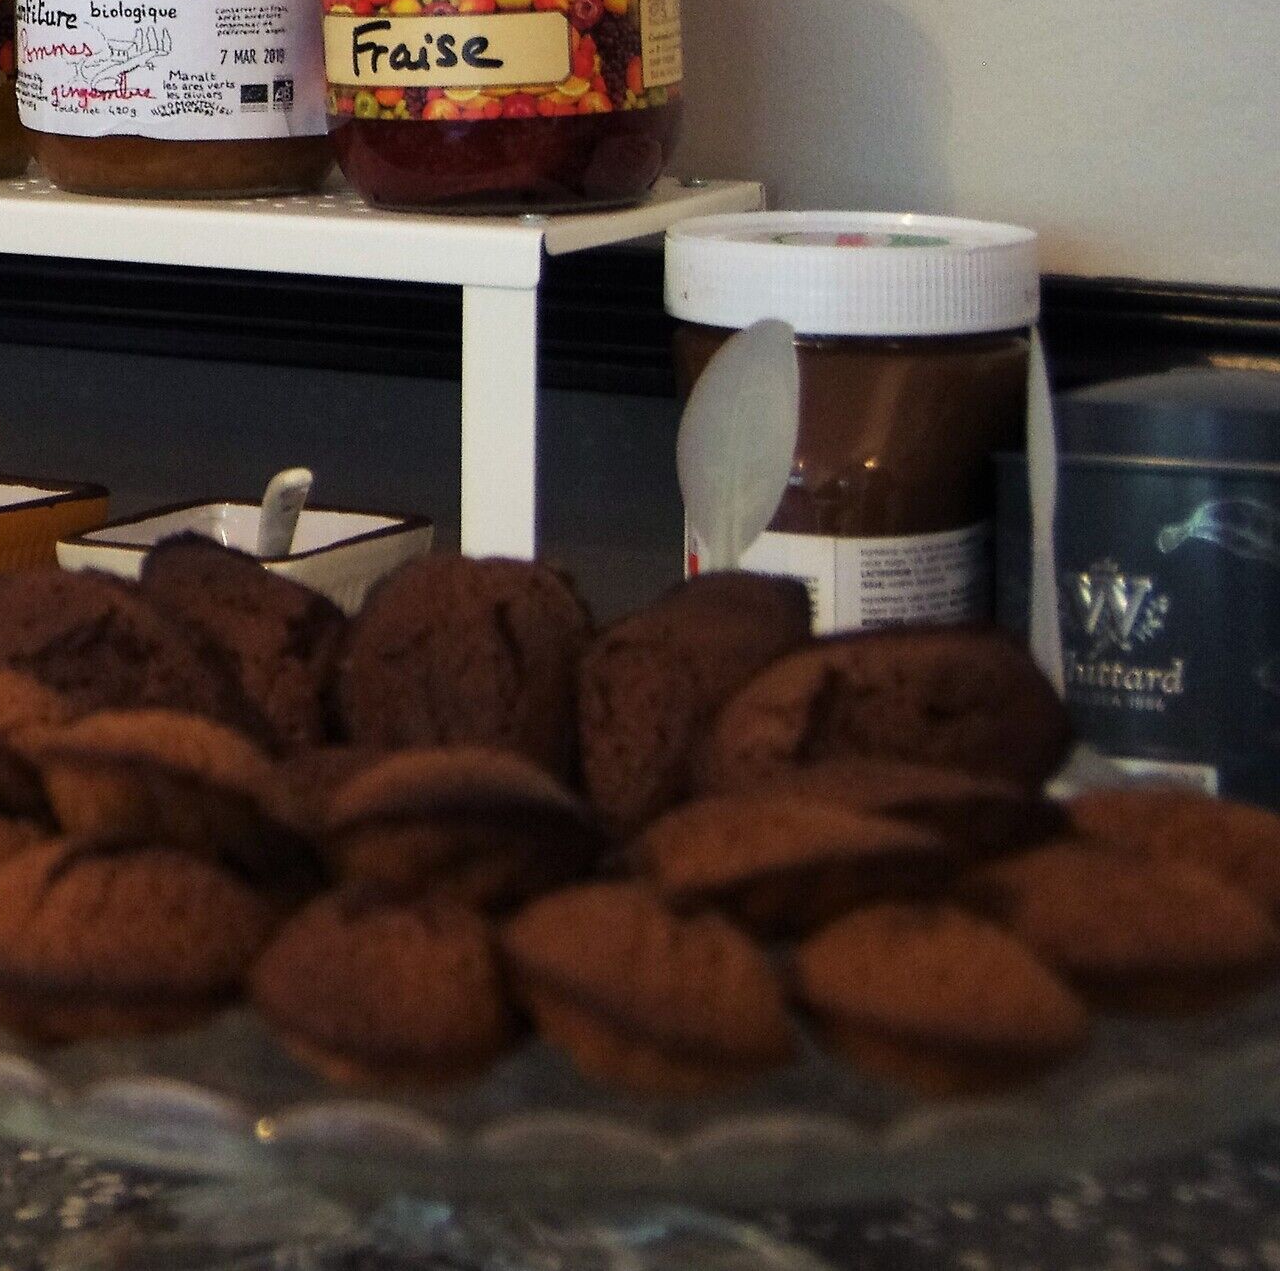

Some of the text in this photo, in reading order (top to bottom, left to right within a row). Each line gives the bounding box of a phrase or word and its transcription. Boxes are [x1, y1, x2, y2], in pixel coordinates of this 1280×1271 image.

[90, 1, 177, 24] biologique
[234, 48, 258, 65] MAR
[352, 19, 504, 77] Fraise
[1064, 653, 1184, 694] hittard
